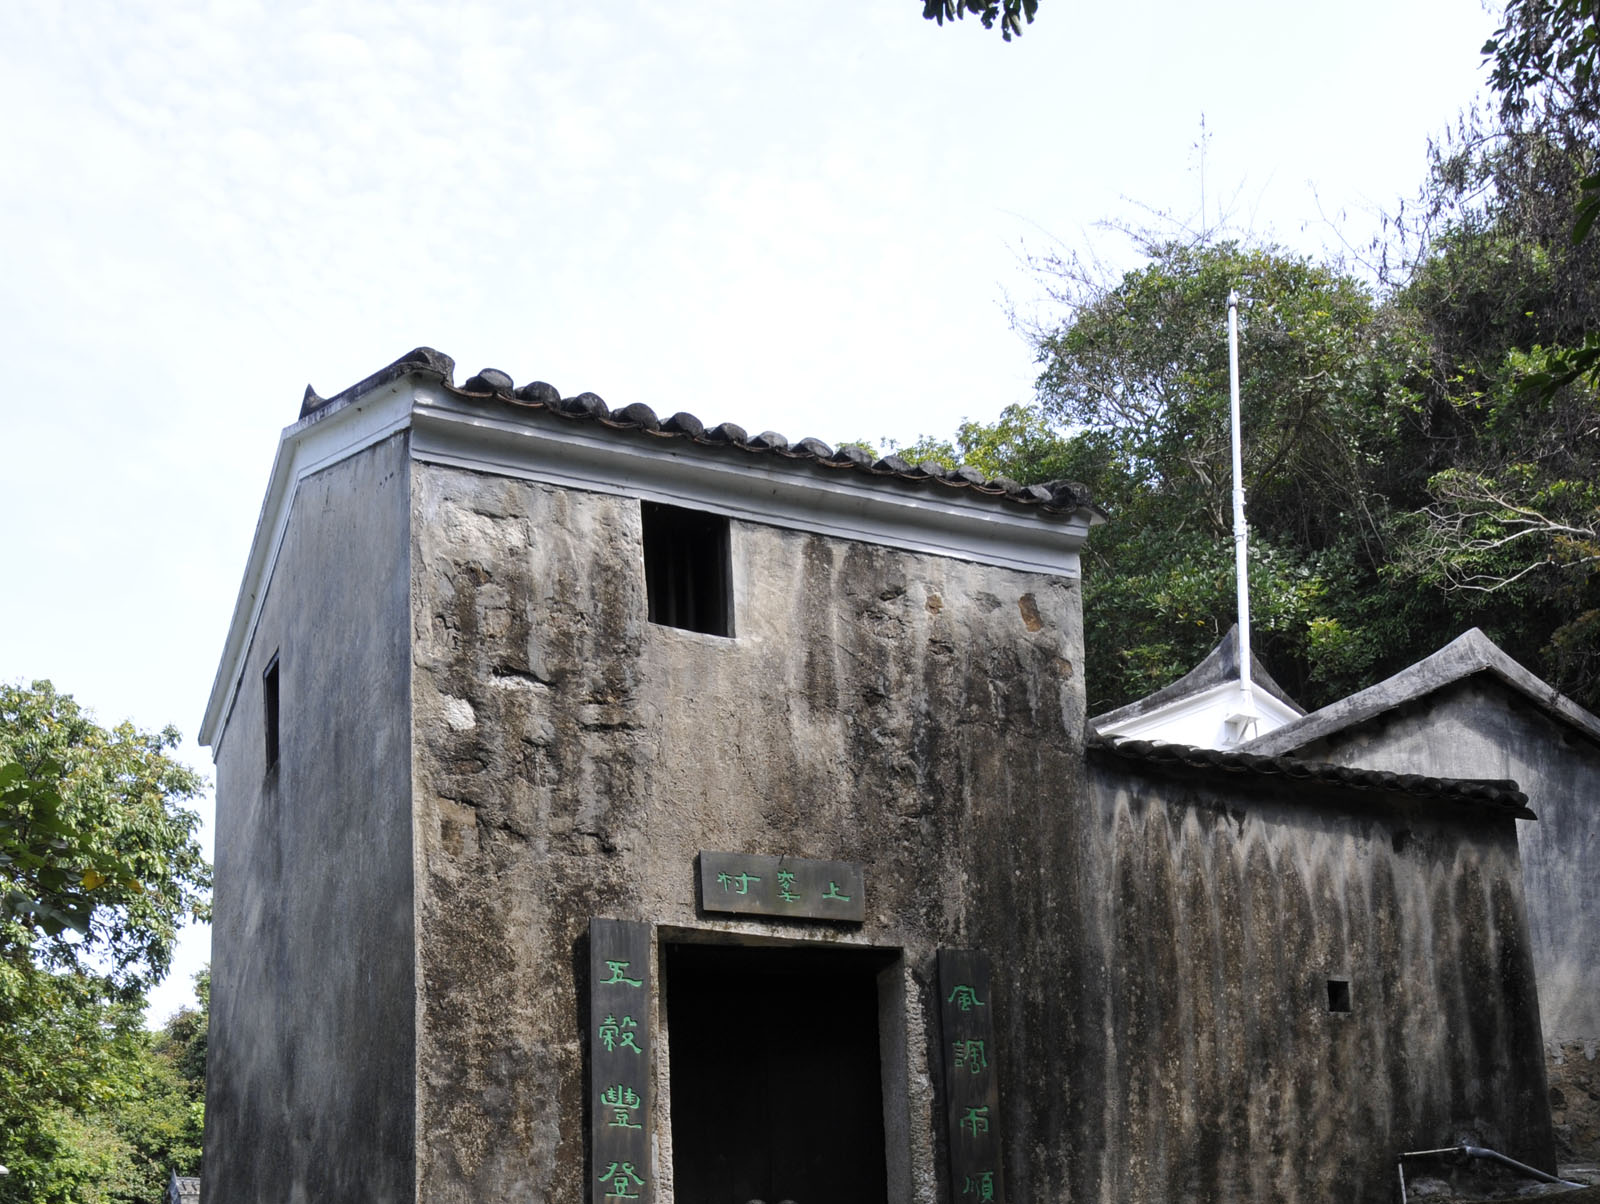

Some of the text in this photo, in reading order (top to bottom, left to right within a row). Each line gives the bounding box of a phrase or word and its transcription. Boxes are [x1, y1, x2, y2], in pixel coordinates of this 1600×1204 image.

[598, 959, 645, 1199] 五穀豐登
[947, 985, 994, 1202] 風調雨順
